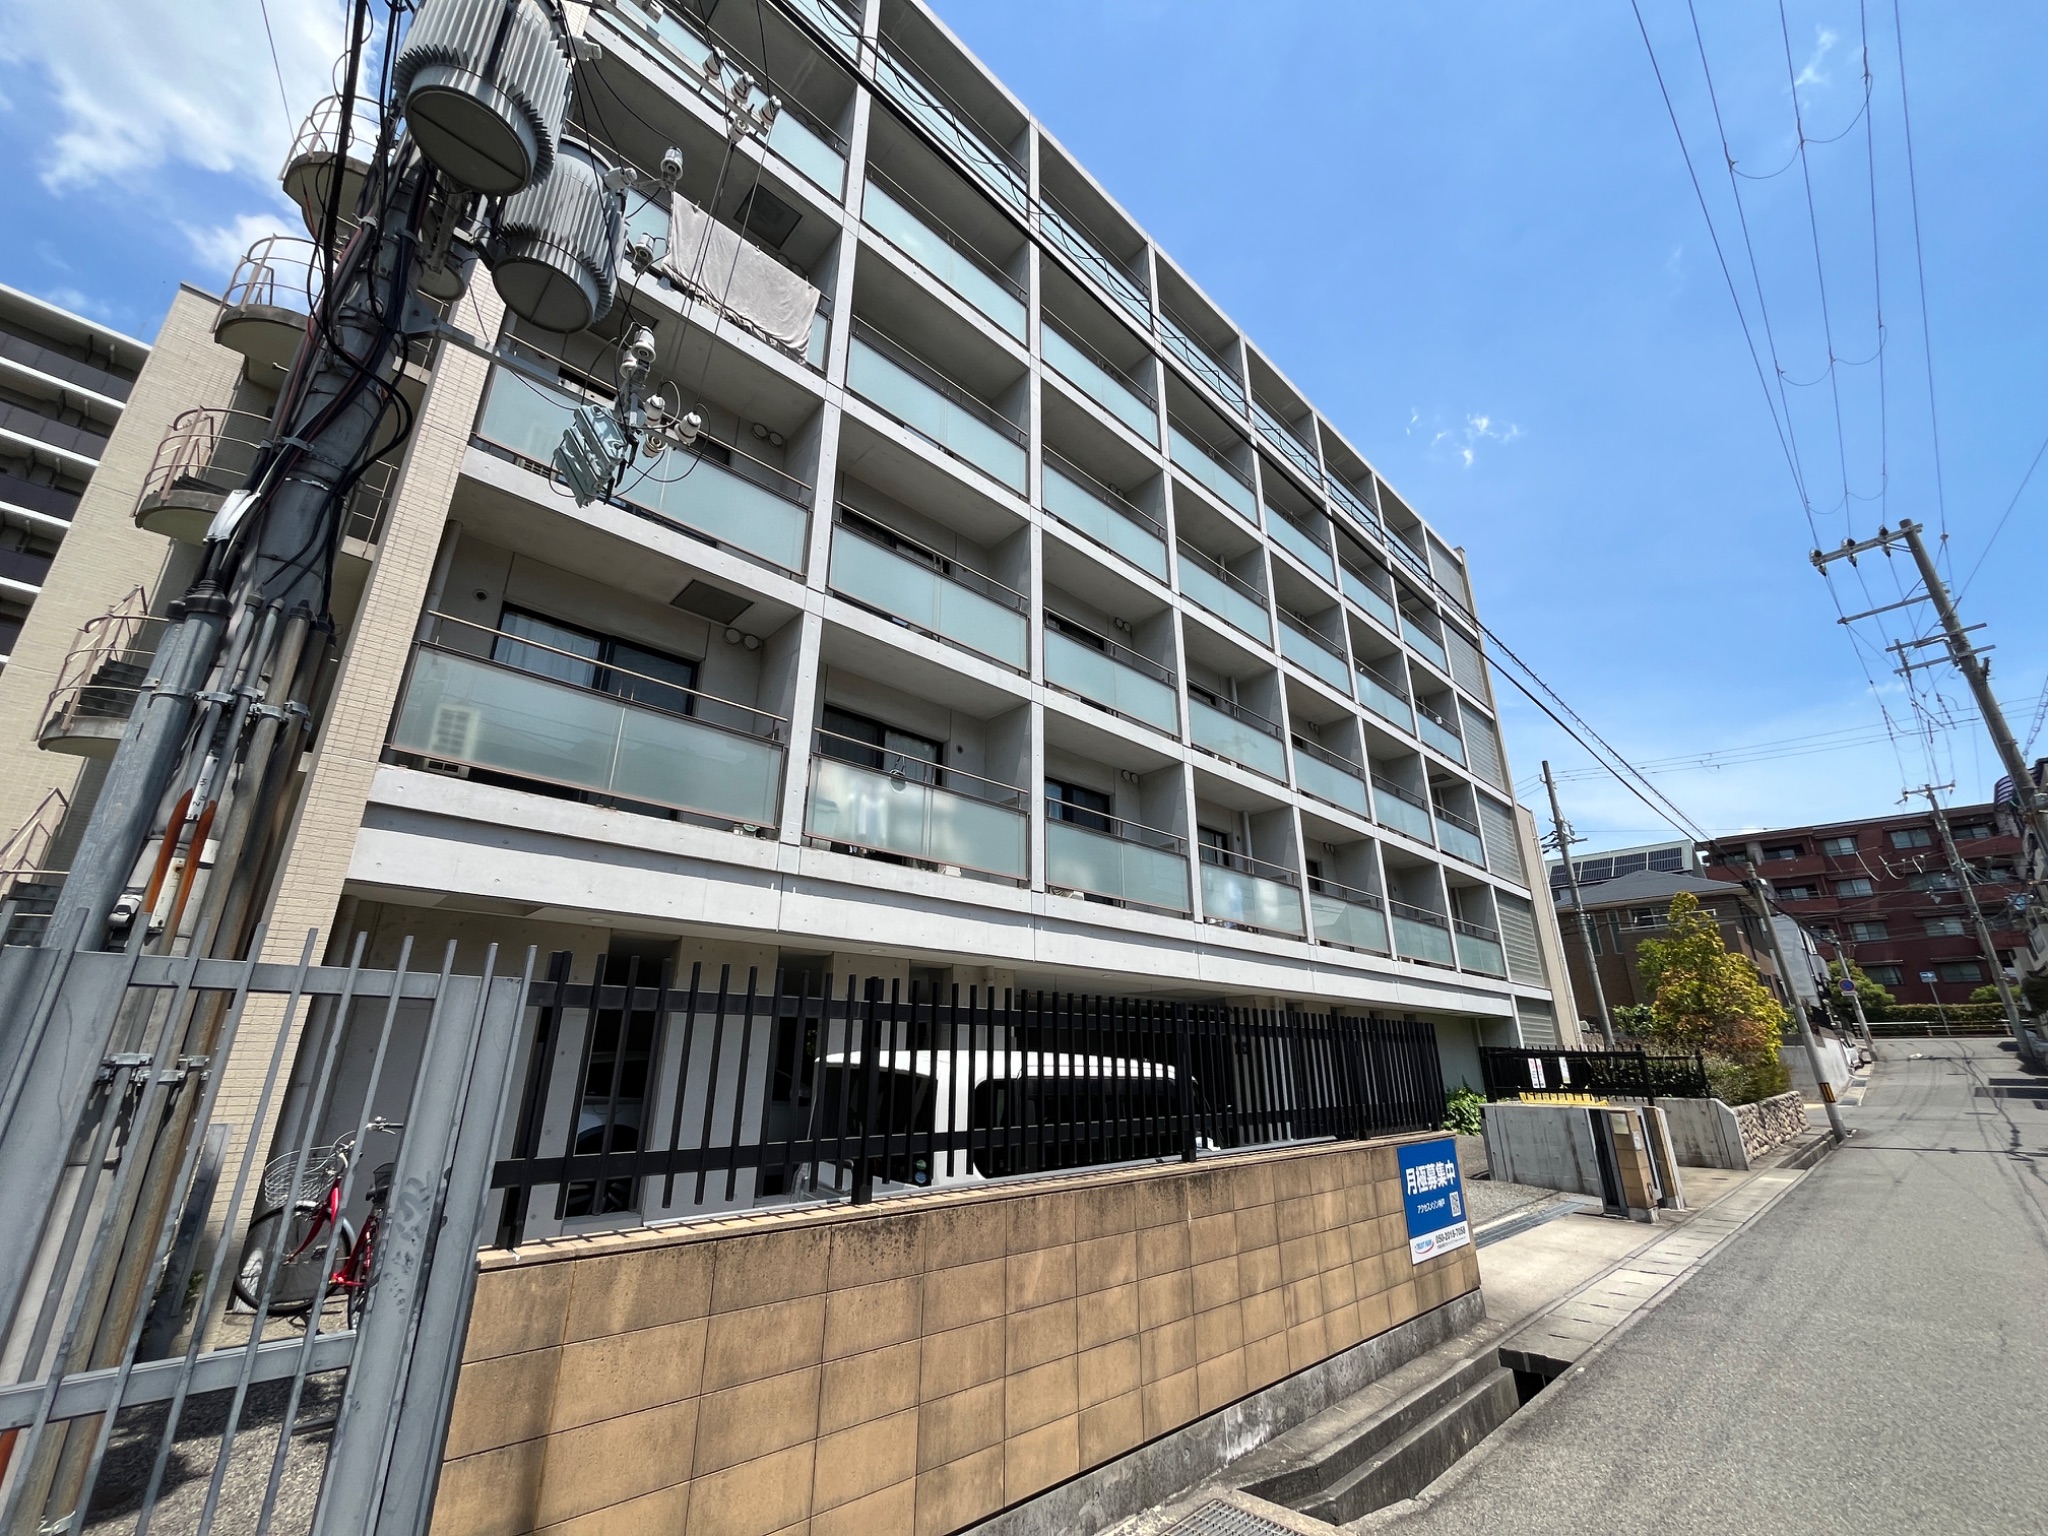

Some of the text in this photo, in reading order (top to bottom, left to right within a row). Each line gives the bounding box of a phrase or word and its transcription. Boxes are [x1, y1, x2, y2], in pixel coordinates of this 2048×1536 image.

[1405, 1159, 1456, 1195] 月極募集中
